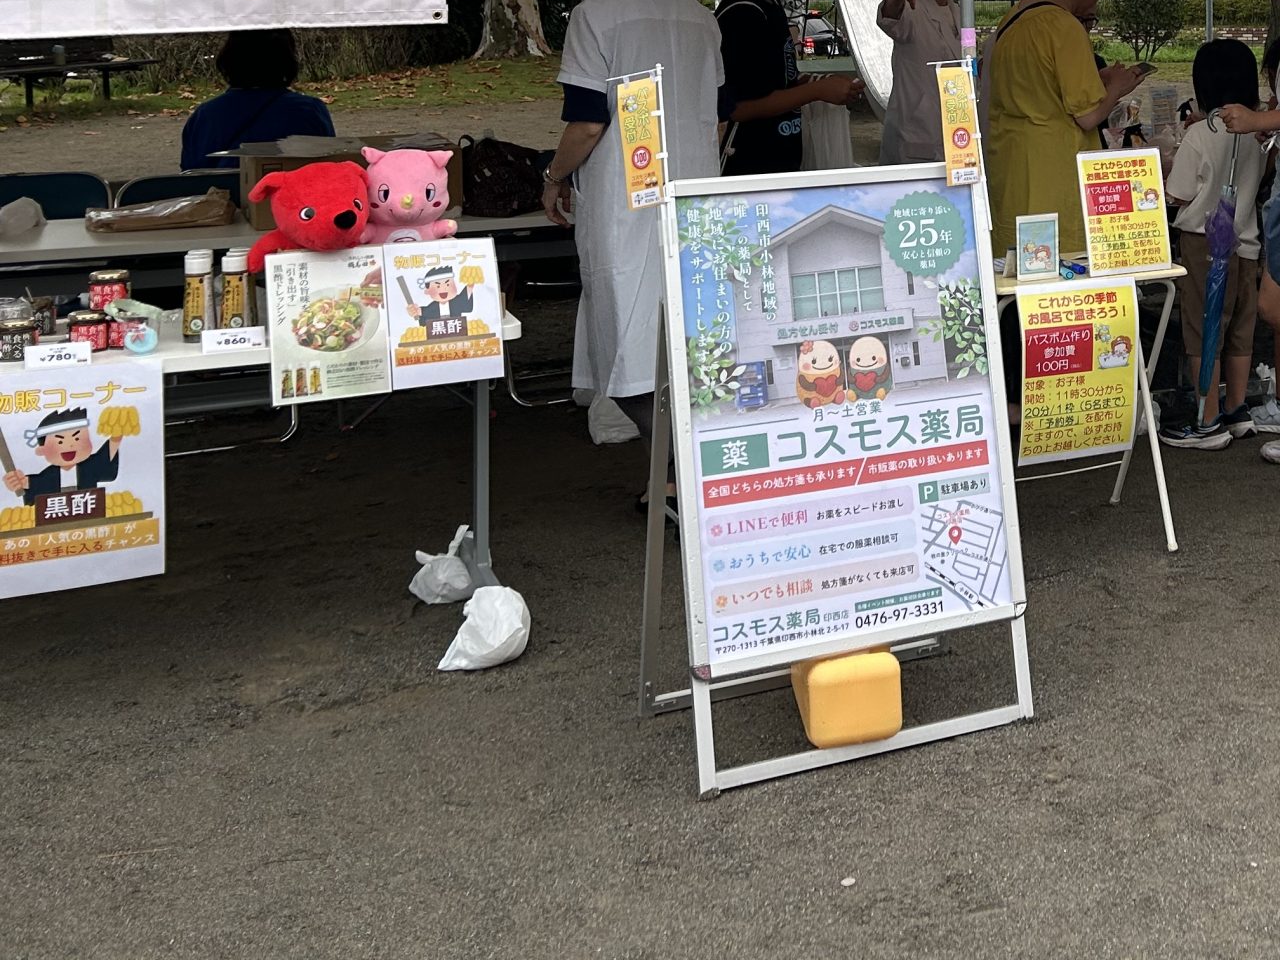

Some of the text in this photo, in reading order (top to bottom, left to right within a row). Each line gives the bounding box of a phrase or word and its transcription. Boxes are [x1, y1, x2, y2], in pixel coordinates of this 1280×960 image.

[1092, 159, 1147, 170] これからの季節
[1087, 184, 1130, 195] バスボム作り
[893, 206, 951, 218] 地域に寄り添い
[1095, 204, 1117, 212] 100円
[393, 250, 487, 270] 物販コーナー
[734, 204, 752, 311] 唯一の薬局として
[756, 203, 777, 321] 印西市小林地域の
[901, 248, 951, 260] 安心と信頼の
[919, 260, 936, 269] 薬局
[687, 209, 709, 363] 健康をサポートします
[709, 208, 732, 353] 地域にお住まいの方の
[1038, 291, 1117, 308] これからの季節
[431, 319, 463, 336] 黒酢
[1028, 330, 1090, 345] バスボム作り
[1044, 345, 1076, 359] 参加費
[1035, 359, 1069, 372] 100円
[777, 404, 984, 462] コスモス薬局
[721, 441, 749, 469] 薬
[924, 480, 987, 500] P 駐車場あり
[44, 492, 97, 519] 黒酢
[727, 509, 808, 535] LINEで便利
[729, 545, 811, 569] おうちで安心
[732, 579, 813, 604] いつでも相談
[855, 601, 944, 628] 0476-97-3331
[712, 609, 850, 643] コスモス薬局 印西店
